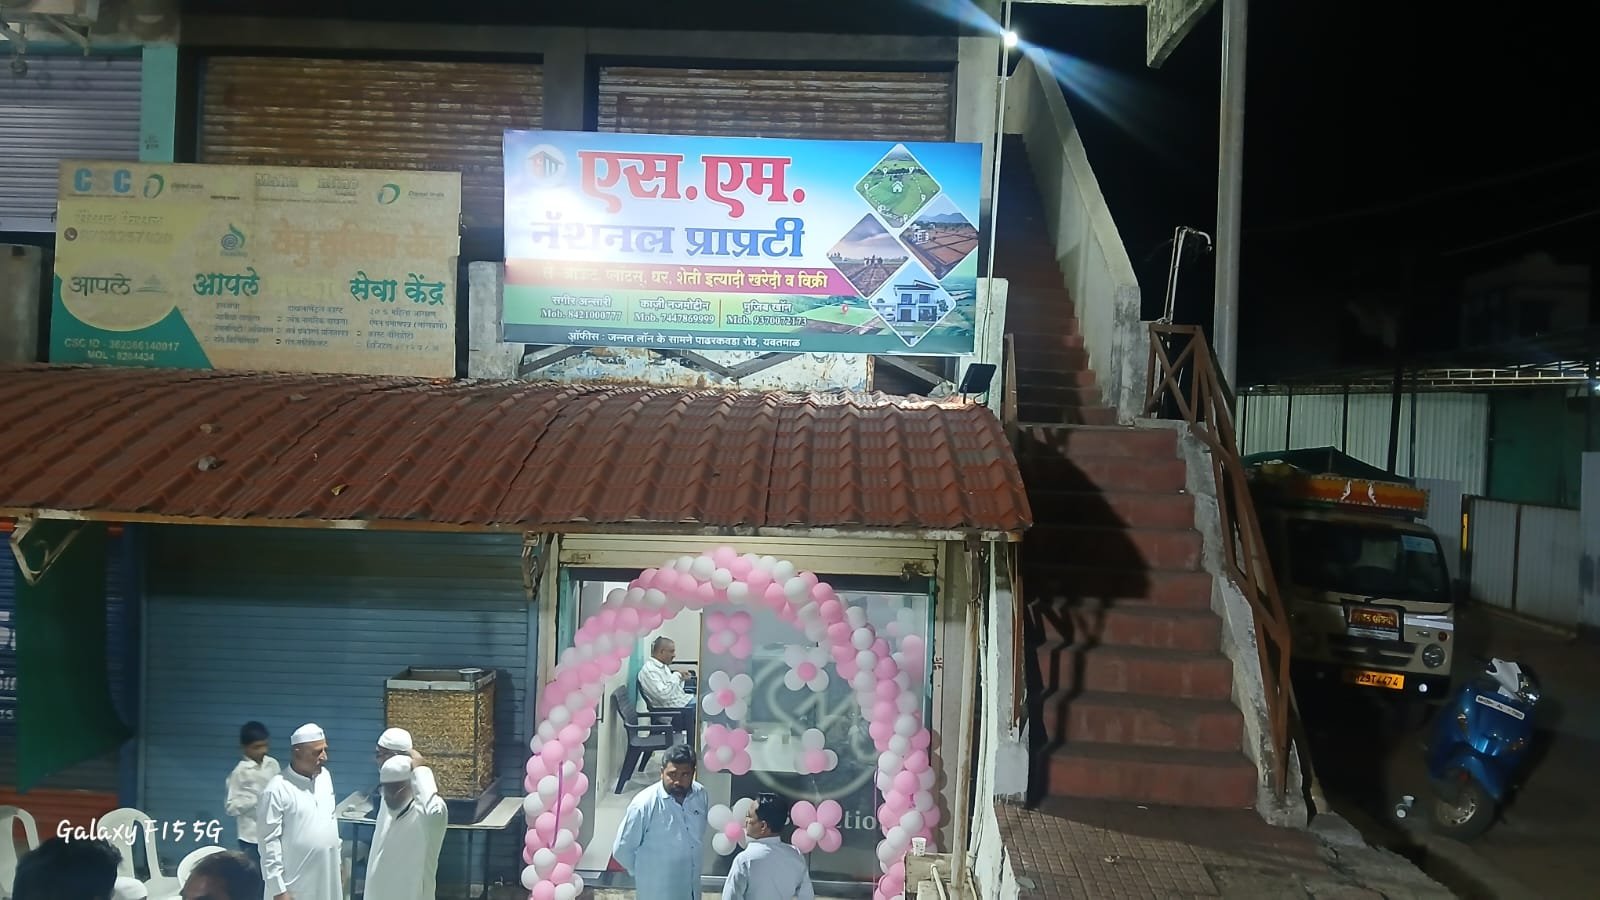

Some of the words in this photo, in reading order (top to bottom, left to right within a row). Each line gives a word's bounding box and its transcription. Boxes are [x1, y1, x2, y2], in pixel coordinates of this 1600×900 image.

[74, 168, 132, 193] CSC
[577, 150, 806, 218] एस.एम.
[69, 273, 132, 296] आपले
[193, 267, 260, 297] आपले
[350, 270, 398, 303] सेवा
[404, 272, 446, 306] केंद्र
[676, 267, 701, 285] शेती
[705, 268, 745, 289] इत्यादी
[749, 269, 781, 290] खरेदी
[785, 274, 794, 287] व
[798, 270, 828, 289] विक्री
[541, 309, 566, 319] Mob.
[635, 312, 659, 323] Mob.
[726, 314, 750, 325] Mob.
[64, 338, 86, 348] CSC
[636, 330, 654, 343] लॉन
[656, 332, 666, 343] के
[668, 333, 693, 345] सामने
